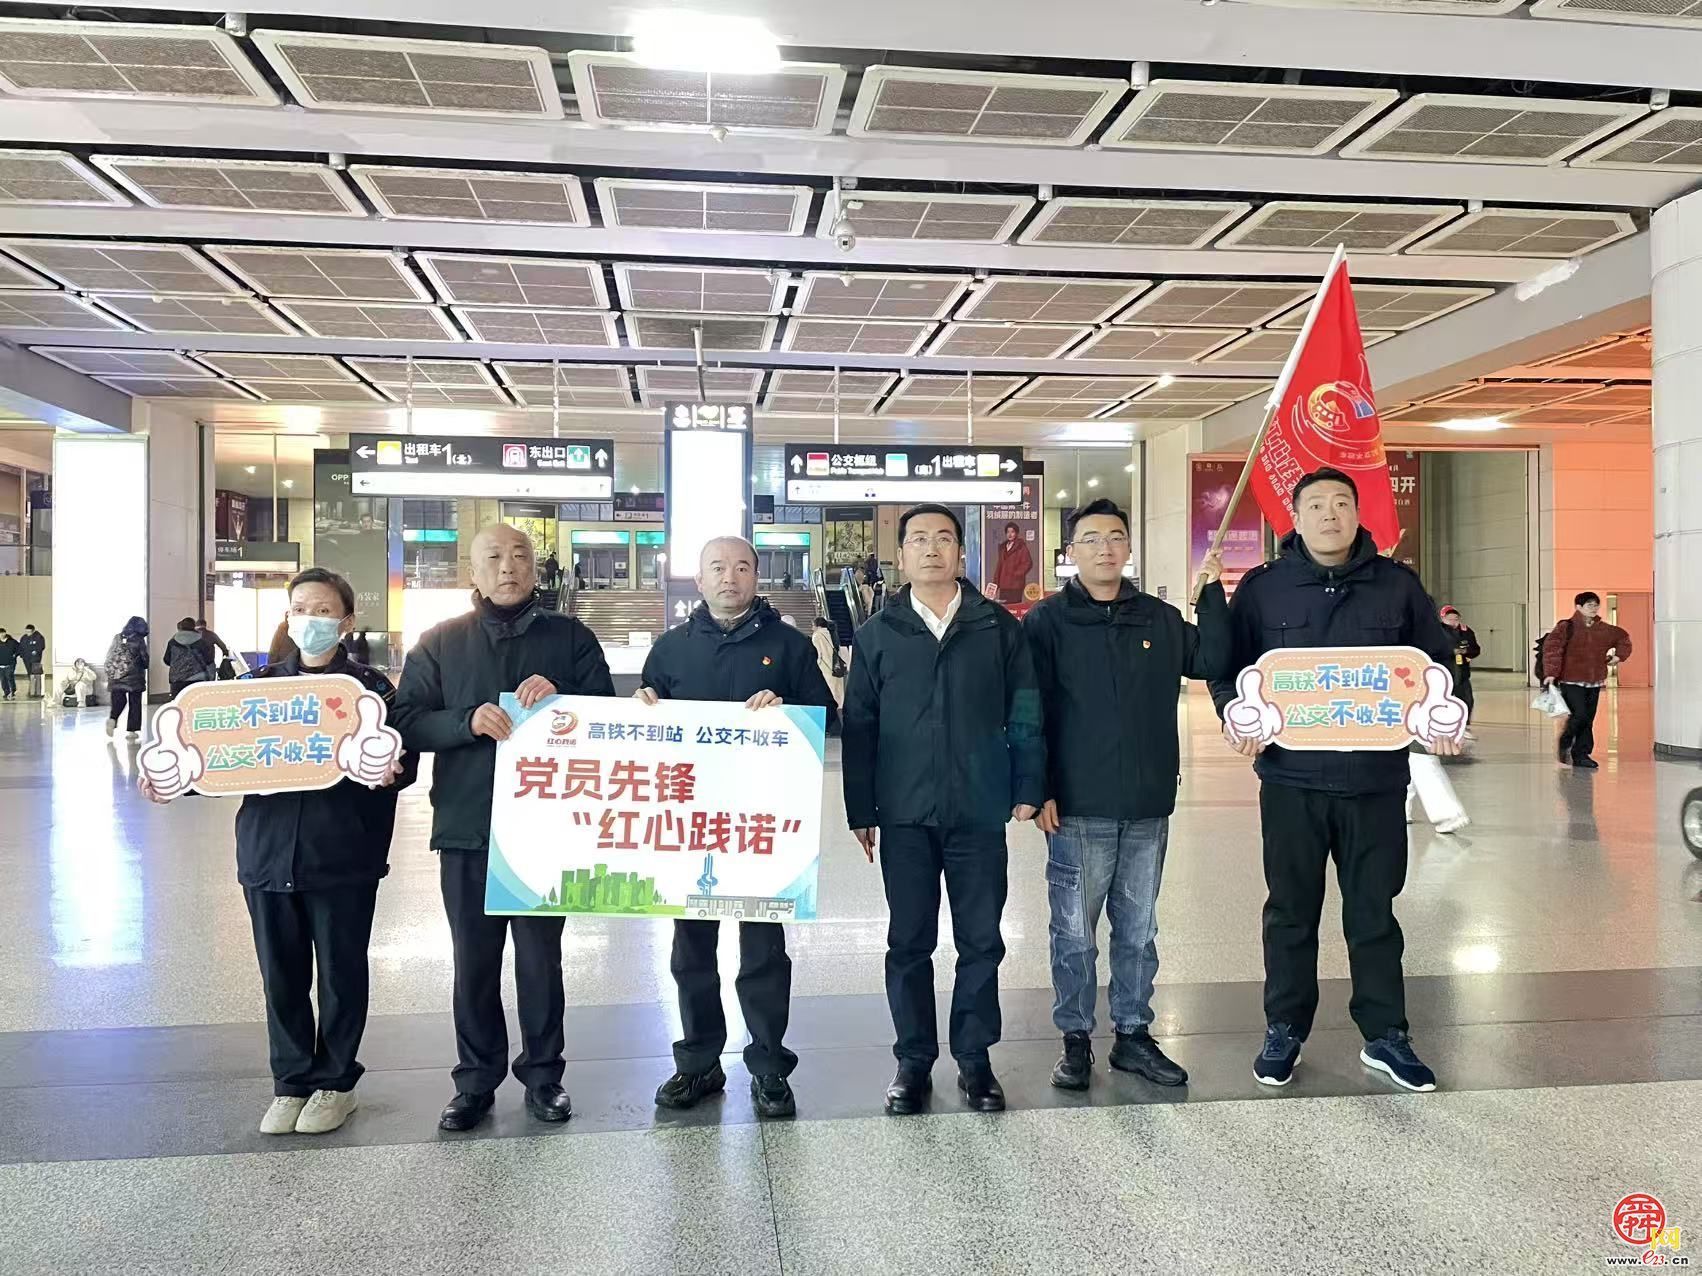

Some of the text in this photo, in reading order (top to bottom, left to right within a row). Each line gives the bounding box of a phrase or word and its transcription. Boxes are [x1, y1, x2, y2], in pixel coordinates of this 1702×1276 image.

[529, 445, 566, 459] 东出口
[1273, 664, 1390, 692] 高铁不到站
[192, 694, 321, 731] 高铁不到站
[1285, 699, 1403, 728] 公交不收车
[588, 722, 789, 747] 高铁不到站 公交不收车
[206, 732, 334, 771] 公交不收车
[513, 756, 696, 803] 党员先锋
[572, 809, 802, 855] “红心践诺”
